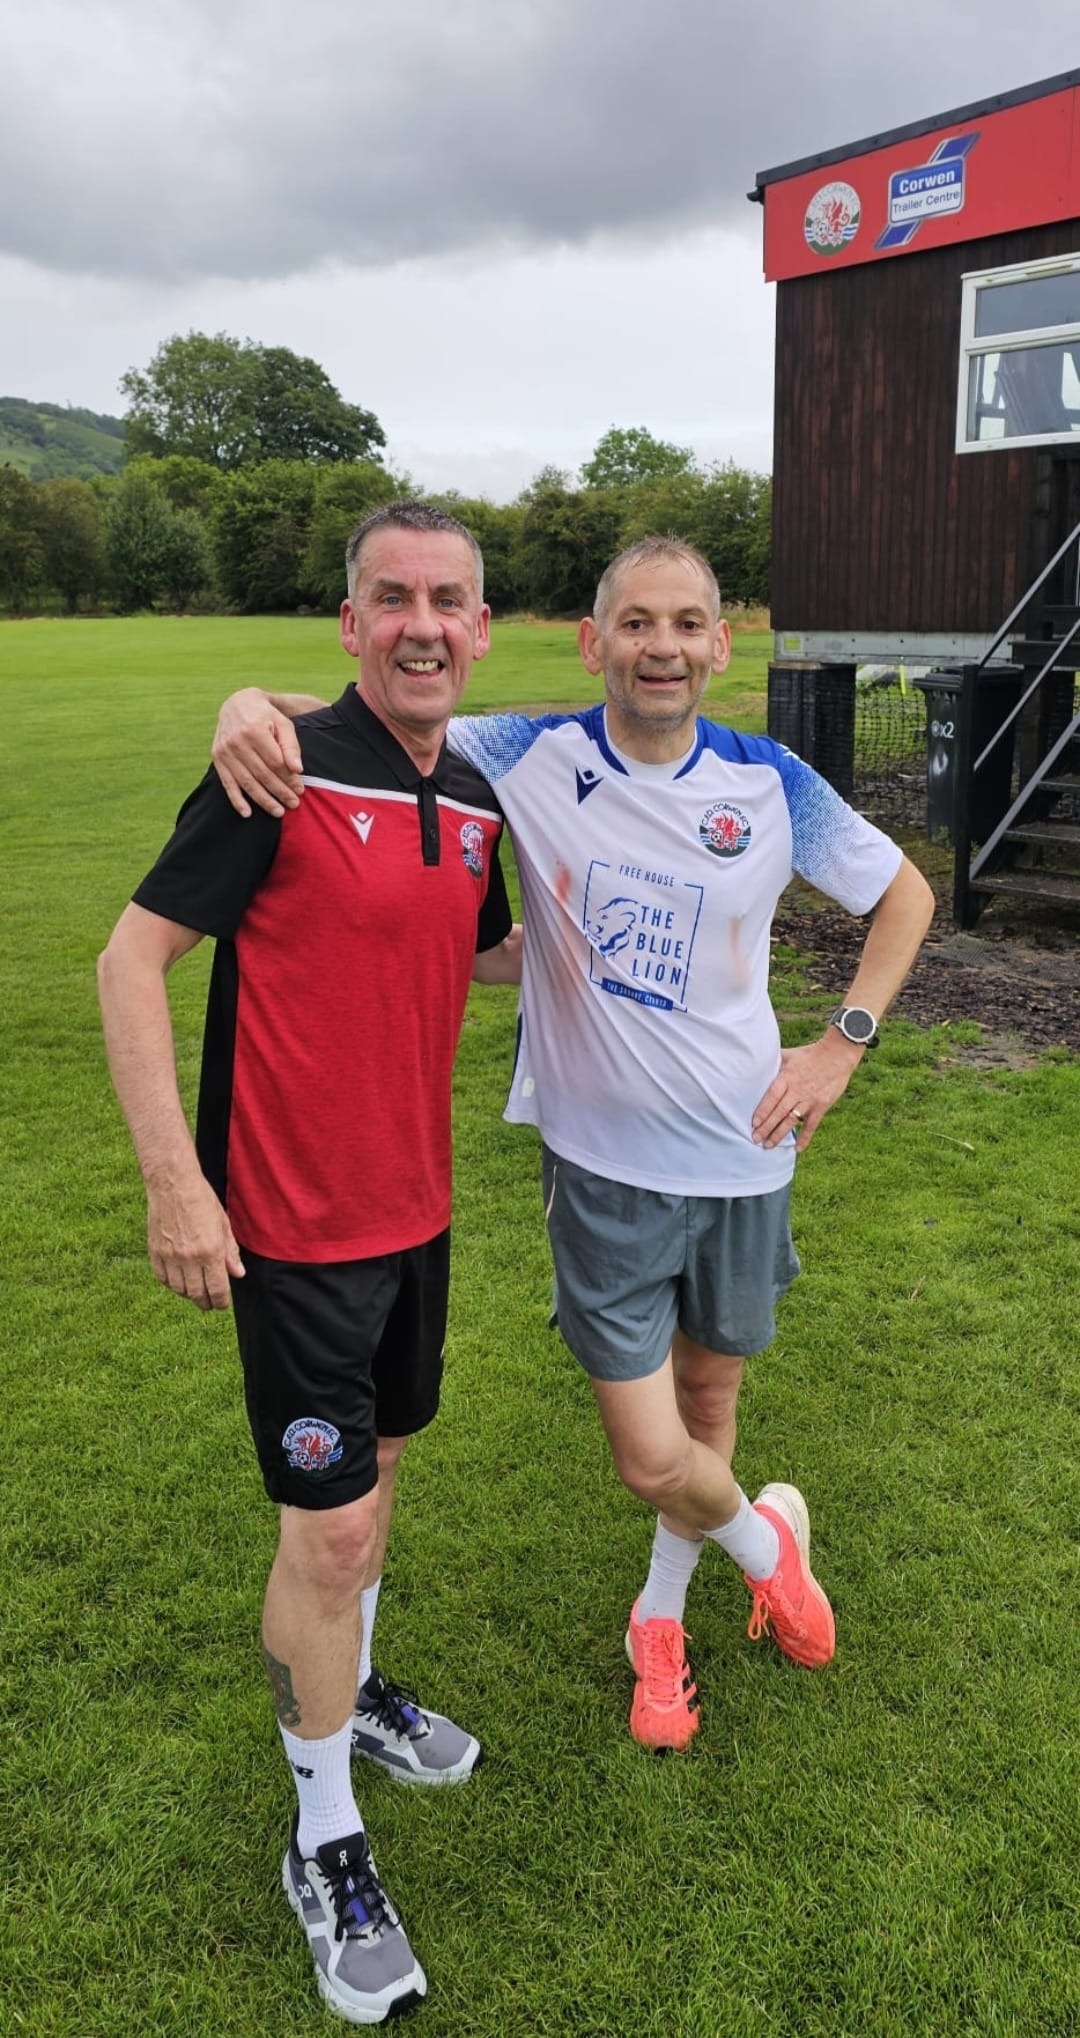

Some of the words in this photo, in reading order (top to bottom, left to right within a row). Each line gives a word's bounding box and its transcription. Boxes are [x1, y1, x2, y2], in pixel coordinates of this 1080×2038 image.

[899, 169, 955, 194] Corwen
[894, 200, 922, 213] Trailer
[925, 191, 960, 205] Centre
[619, 864, 641, 880] FREE
[644, 870, 676, 887] HOUSE
[640, 905, 675, 930] THE
[636, 932, 684, 959] BLUE
[632, 959, 682, 986] LION
